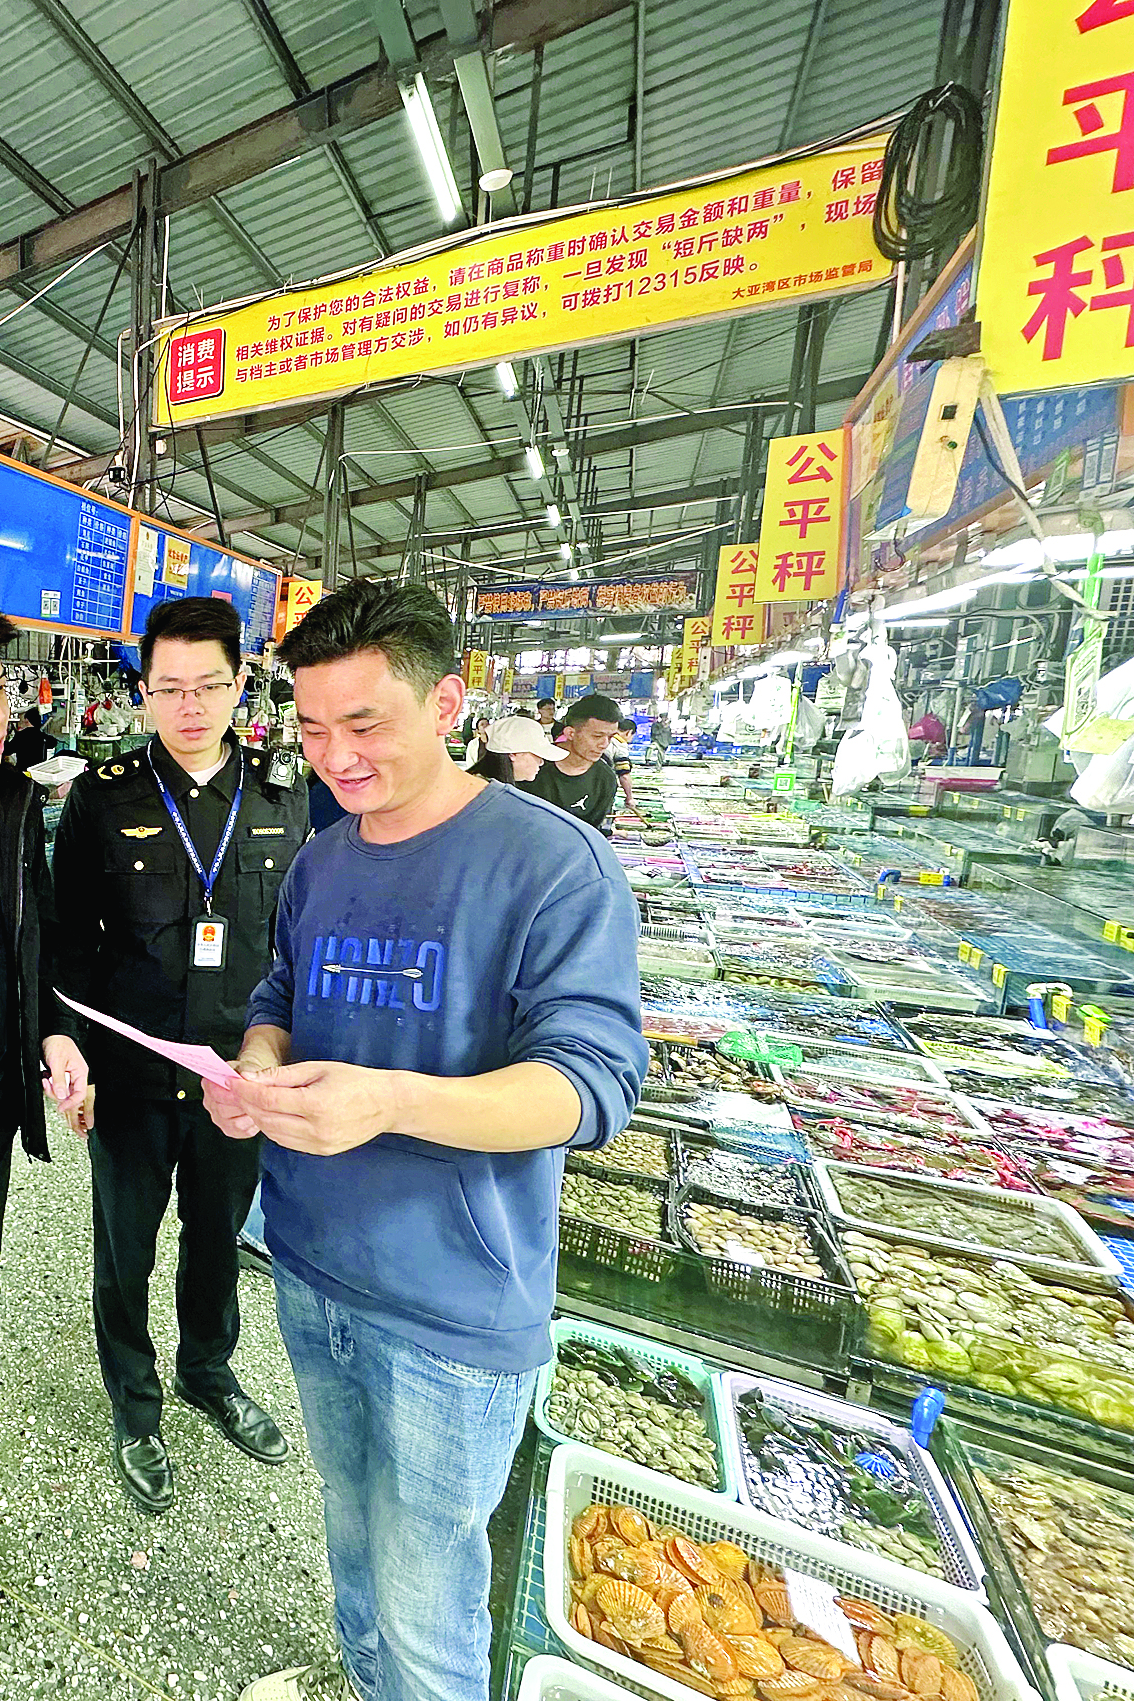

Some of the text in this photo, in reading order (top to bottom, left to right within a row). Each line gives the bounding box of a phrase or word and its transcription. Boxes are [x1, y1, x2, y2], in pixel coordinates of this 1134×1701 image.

[731, 260, 873, 299] 大亚湾区市场监管局
[177, 338, 215, 366] 消费
[176, 366, 215, 393] 提示
[771, 441, 839, 593] 公平秤
[722, 549, 758, 640] 公平秤
[472, 653, 484, 687] 公平秤
